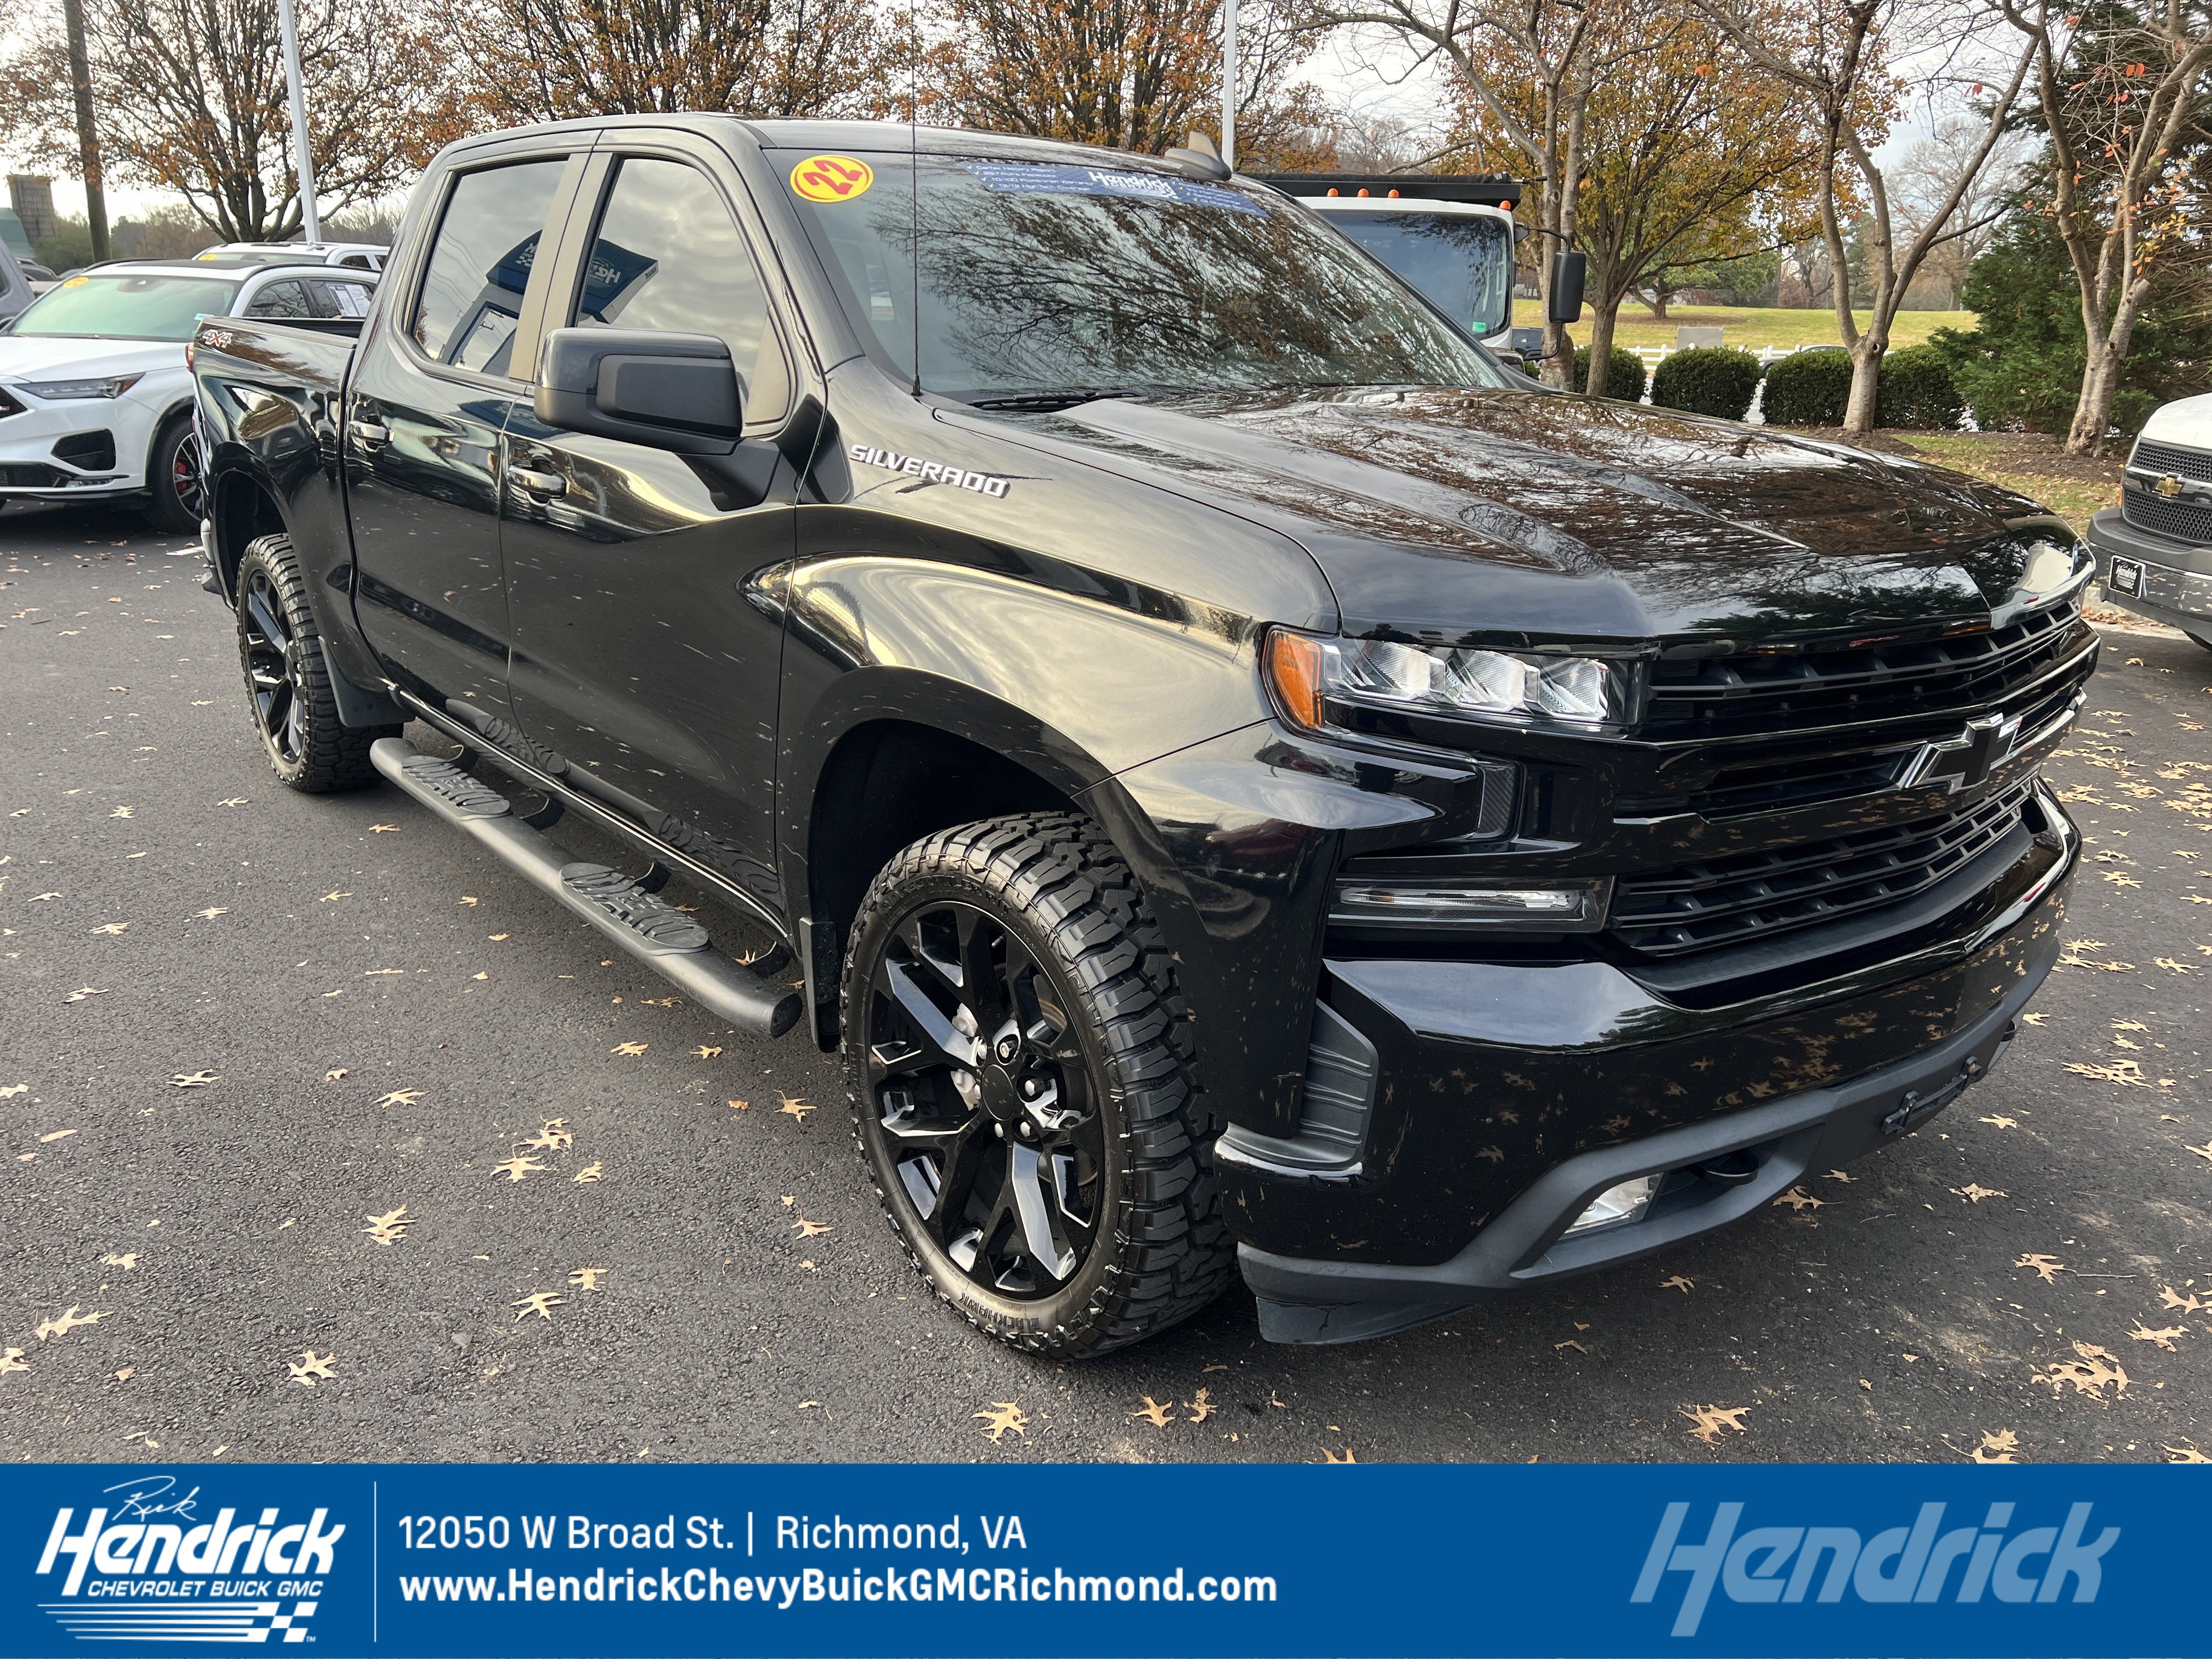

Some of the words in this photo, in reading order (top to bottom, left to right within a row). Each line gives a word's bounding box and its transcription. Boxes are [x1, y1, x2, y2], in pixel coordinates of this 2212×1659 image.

[803, 160, 864, 195] 22
[1088, 171, 1172, 191] Hendrick
[849, 444, 1011, 499] SILVERADO
[959, 1292, 1041, 1330] BLACKHAWK
